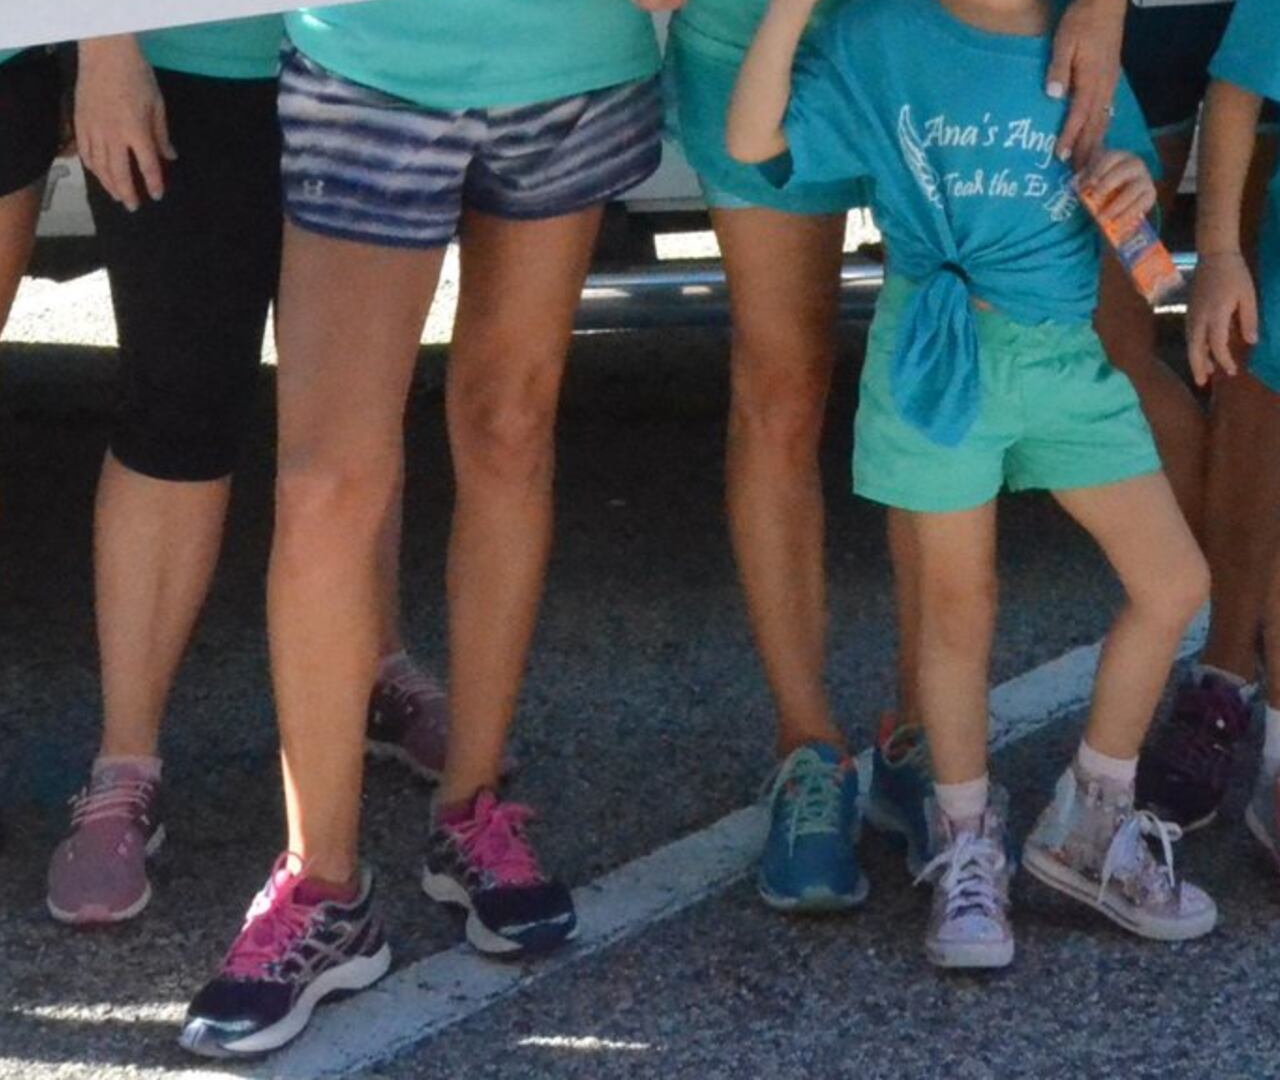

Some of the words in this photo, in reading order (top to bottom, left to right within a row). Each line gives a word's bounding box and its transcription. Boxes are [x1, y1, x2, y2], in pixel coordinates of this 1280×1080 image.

[921, 111, 999, 148] Ana's
[1003, 119, 1058, 169] Ang
[988, 168, 1019, 197] the
